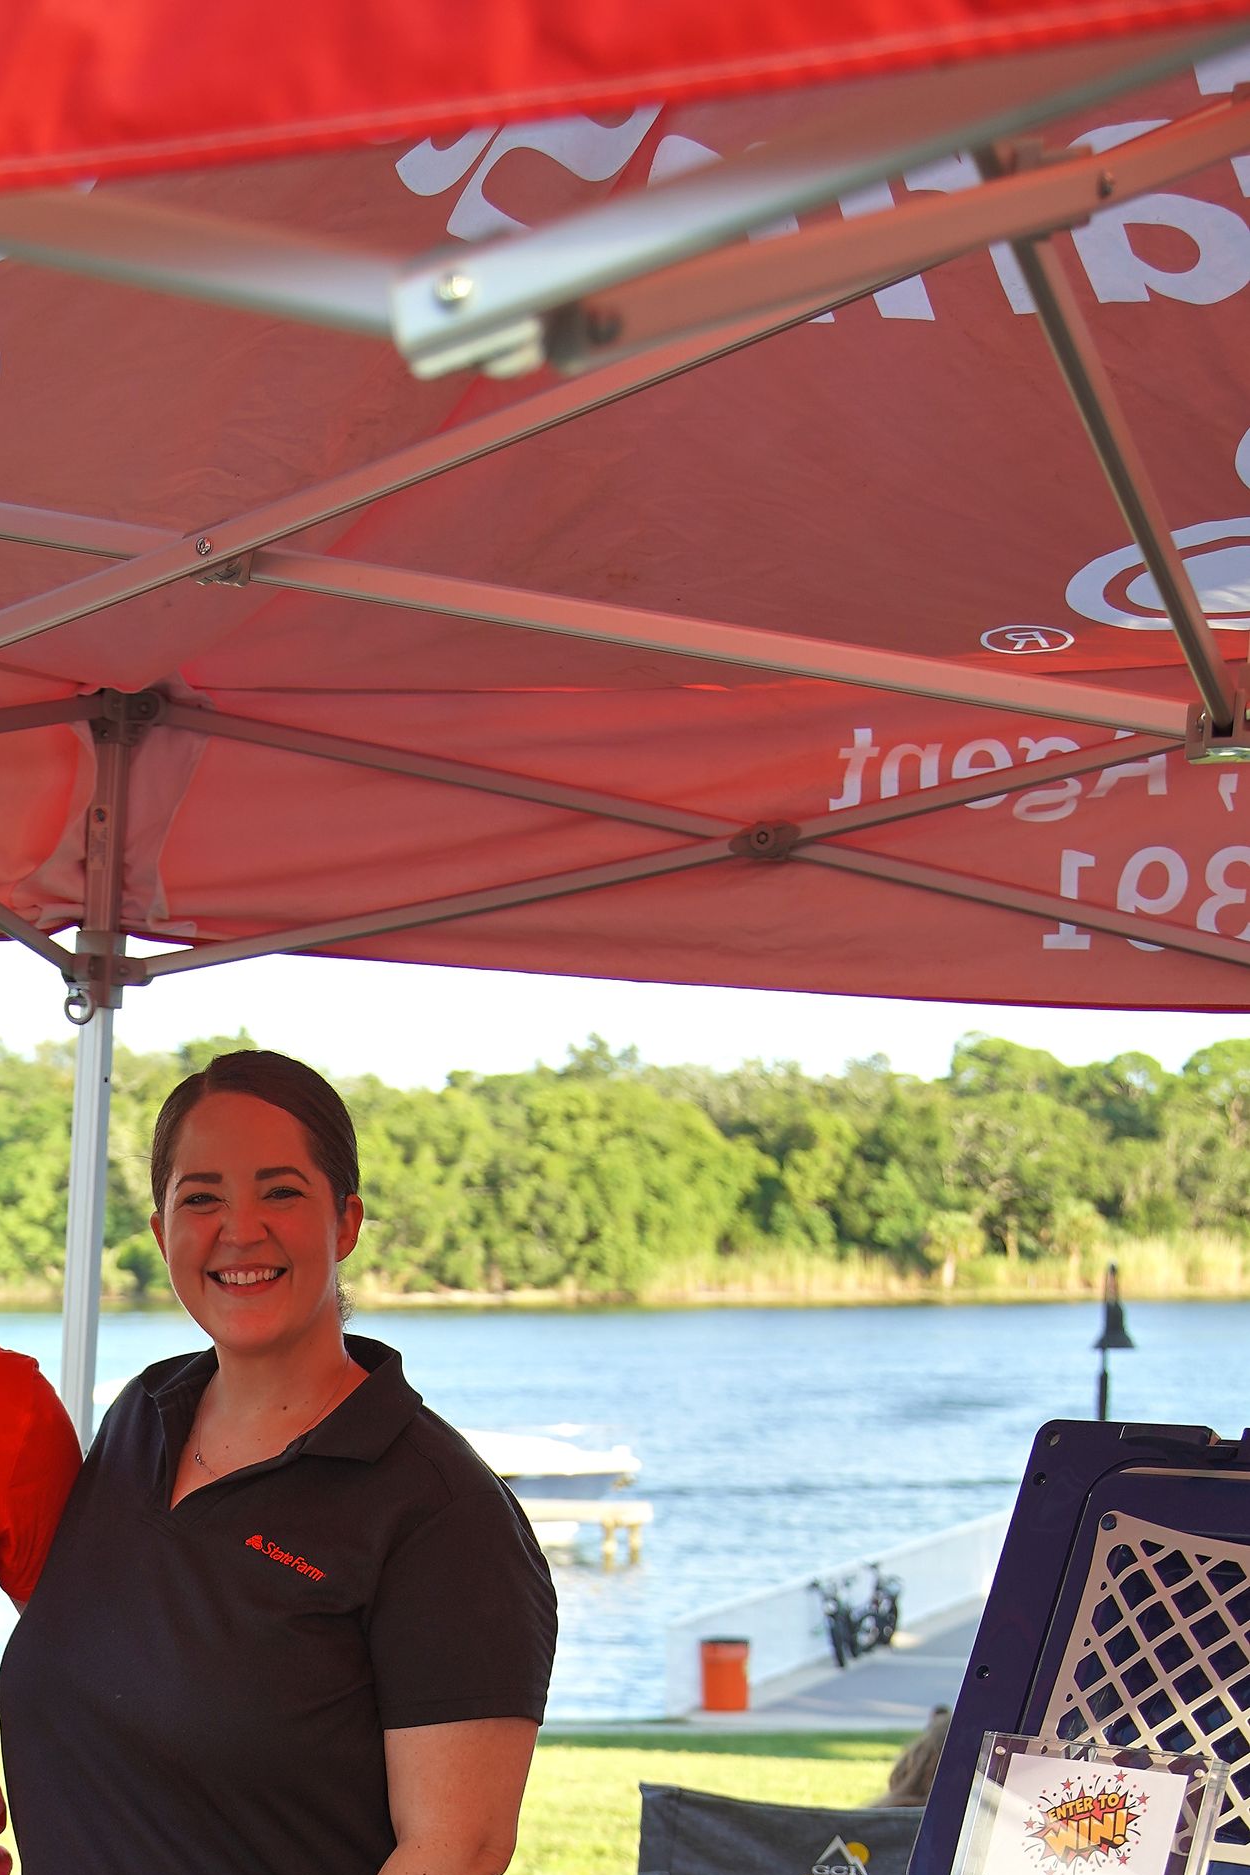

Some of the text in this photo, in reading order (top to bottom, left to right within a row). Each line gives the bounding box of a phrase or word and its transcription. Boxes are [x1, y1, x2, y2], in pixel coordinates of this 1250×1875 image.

[1047, 1792, 1121, 1823] ENTER TO
[1043, 1807, 1130, 1855] WIN!
